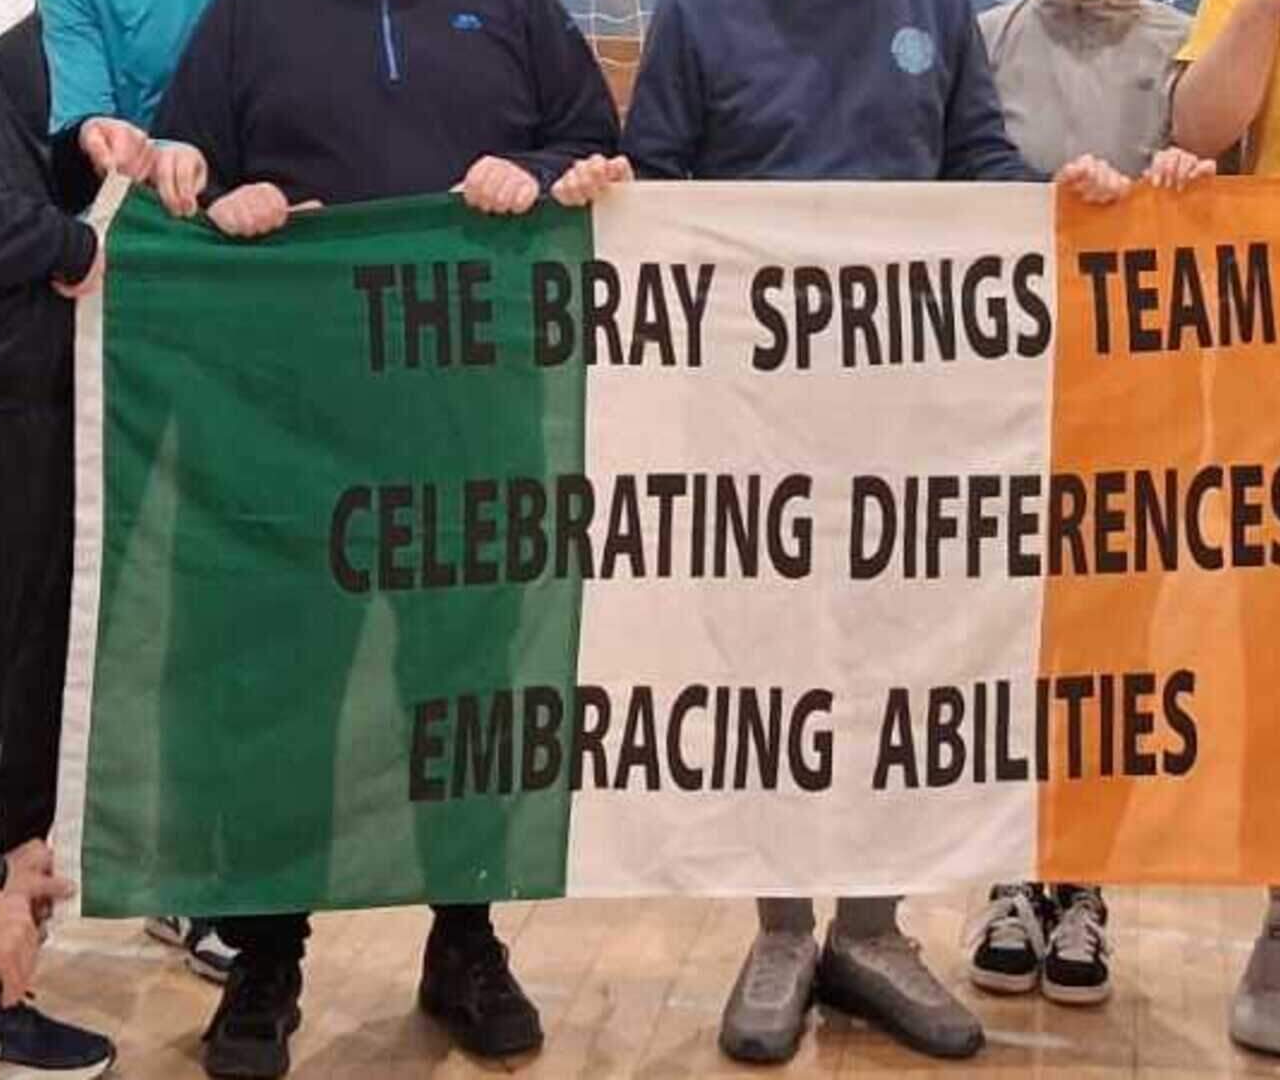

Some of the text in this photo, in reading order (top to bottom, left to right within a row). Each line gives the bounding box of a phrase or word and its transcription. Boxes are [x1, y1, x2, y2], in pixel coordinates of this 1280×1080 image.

[353, 242, 1276, 372] THE BRAY SPRINGS TEAM
[329, 473, 814, 594] CELEBRATING
[407, 669, 1199, 802] EMBRACING ABILITIES
